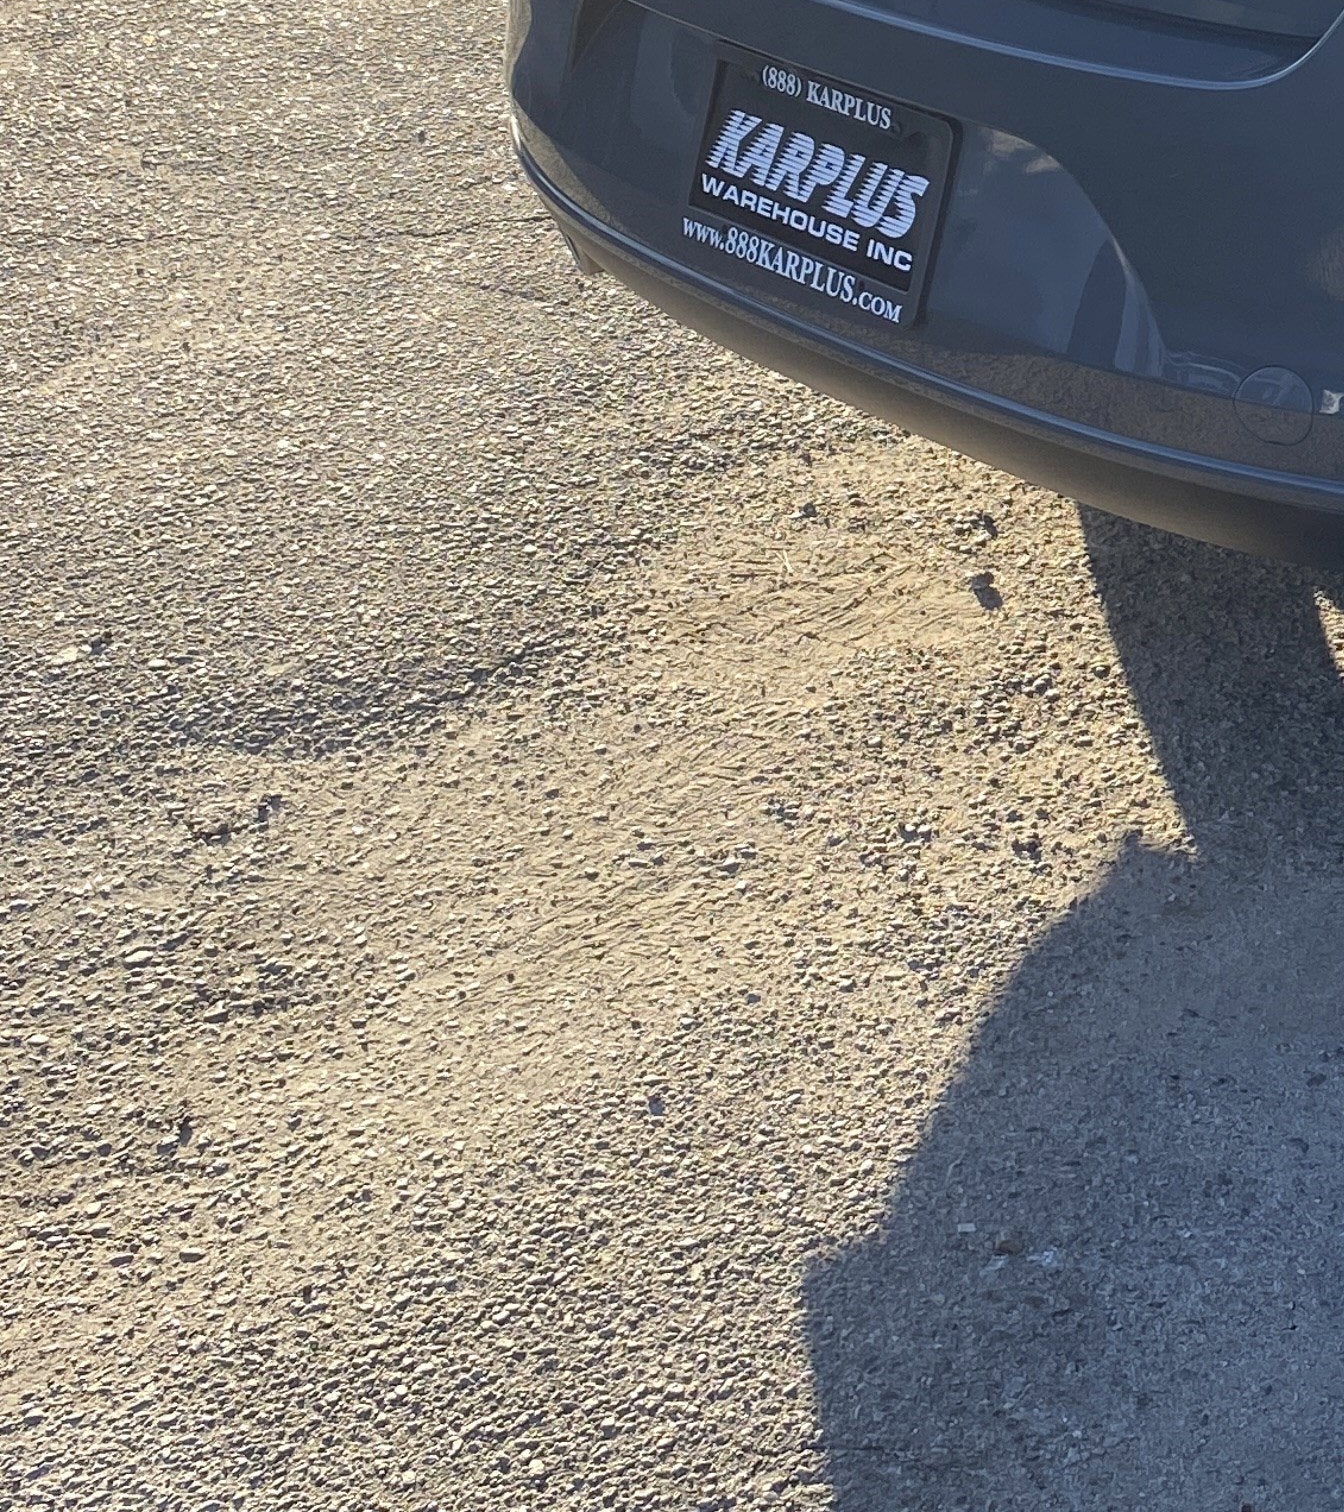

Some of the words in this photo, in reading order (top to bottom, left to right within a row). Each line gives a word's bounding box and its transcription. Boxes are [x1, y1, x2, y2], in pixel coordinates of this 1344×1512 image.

[761, 64, 802, 97] (888)
[805, 79, 892, 130] KARPLUS
[701, 173, 861, 252] WAREHOUSE
[866, 238, 913, 272] INC
[704, 107, 931, 239] KARPLUS
